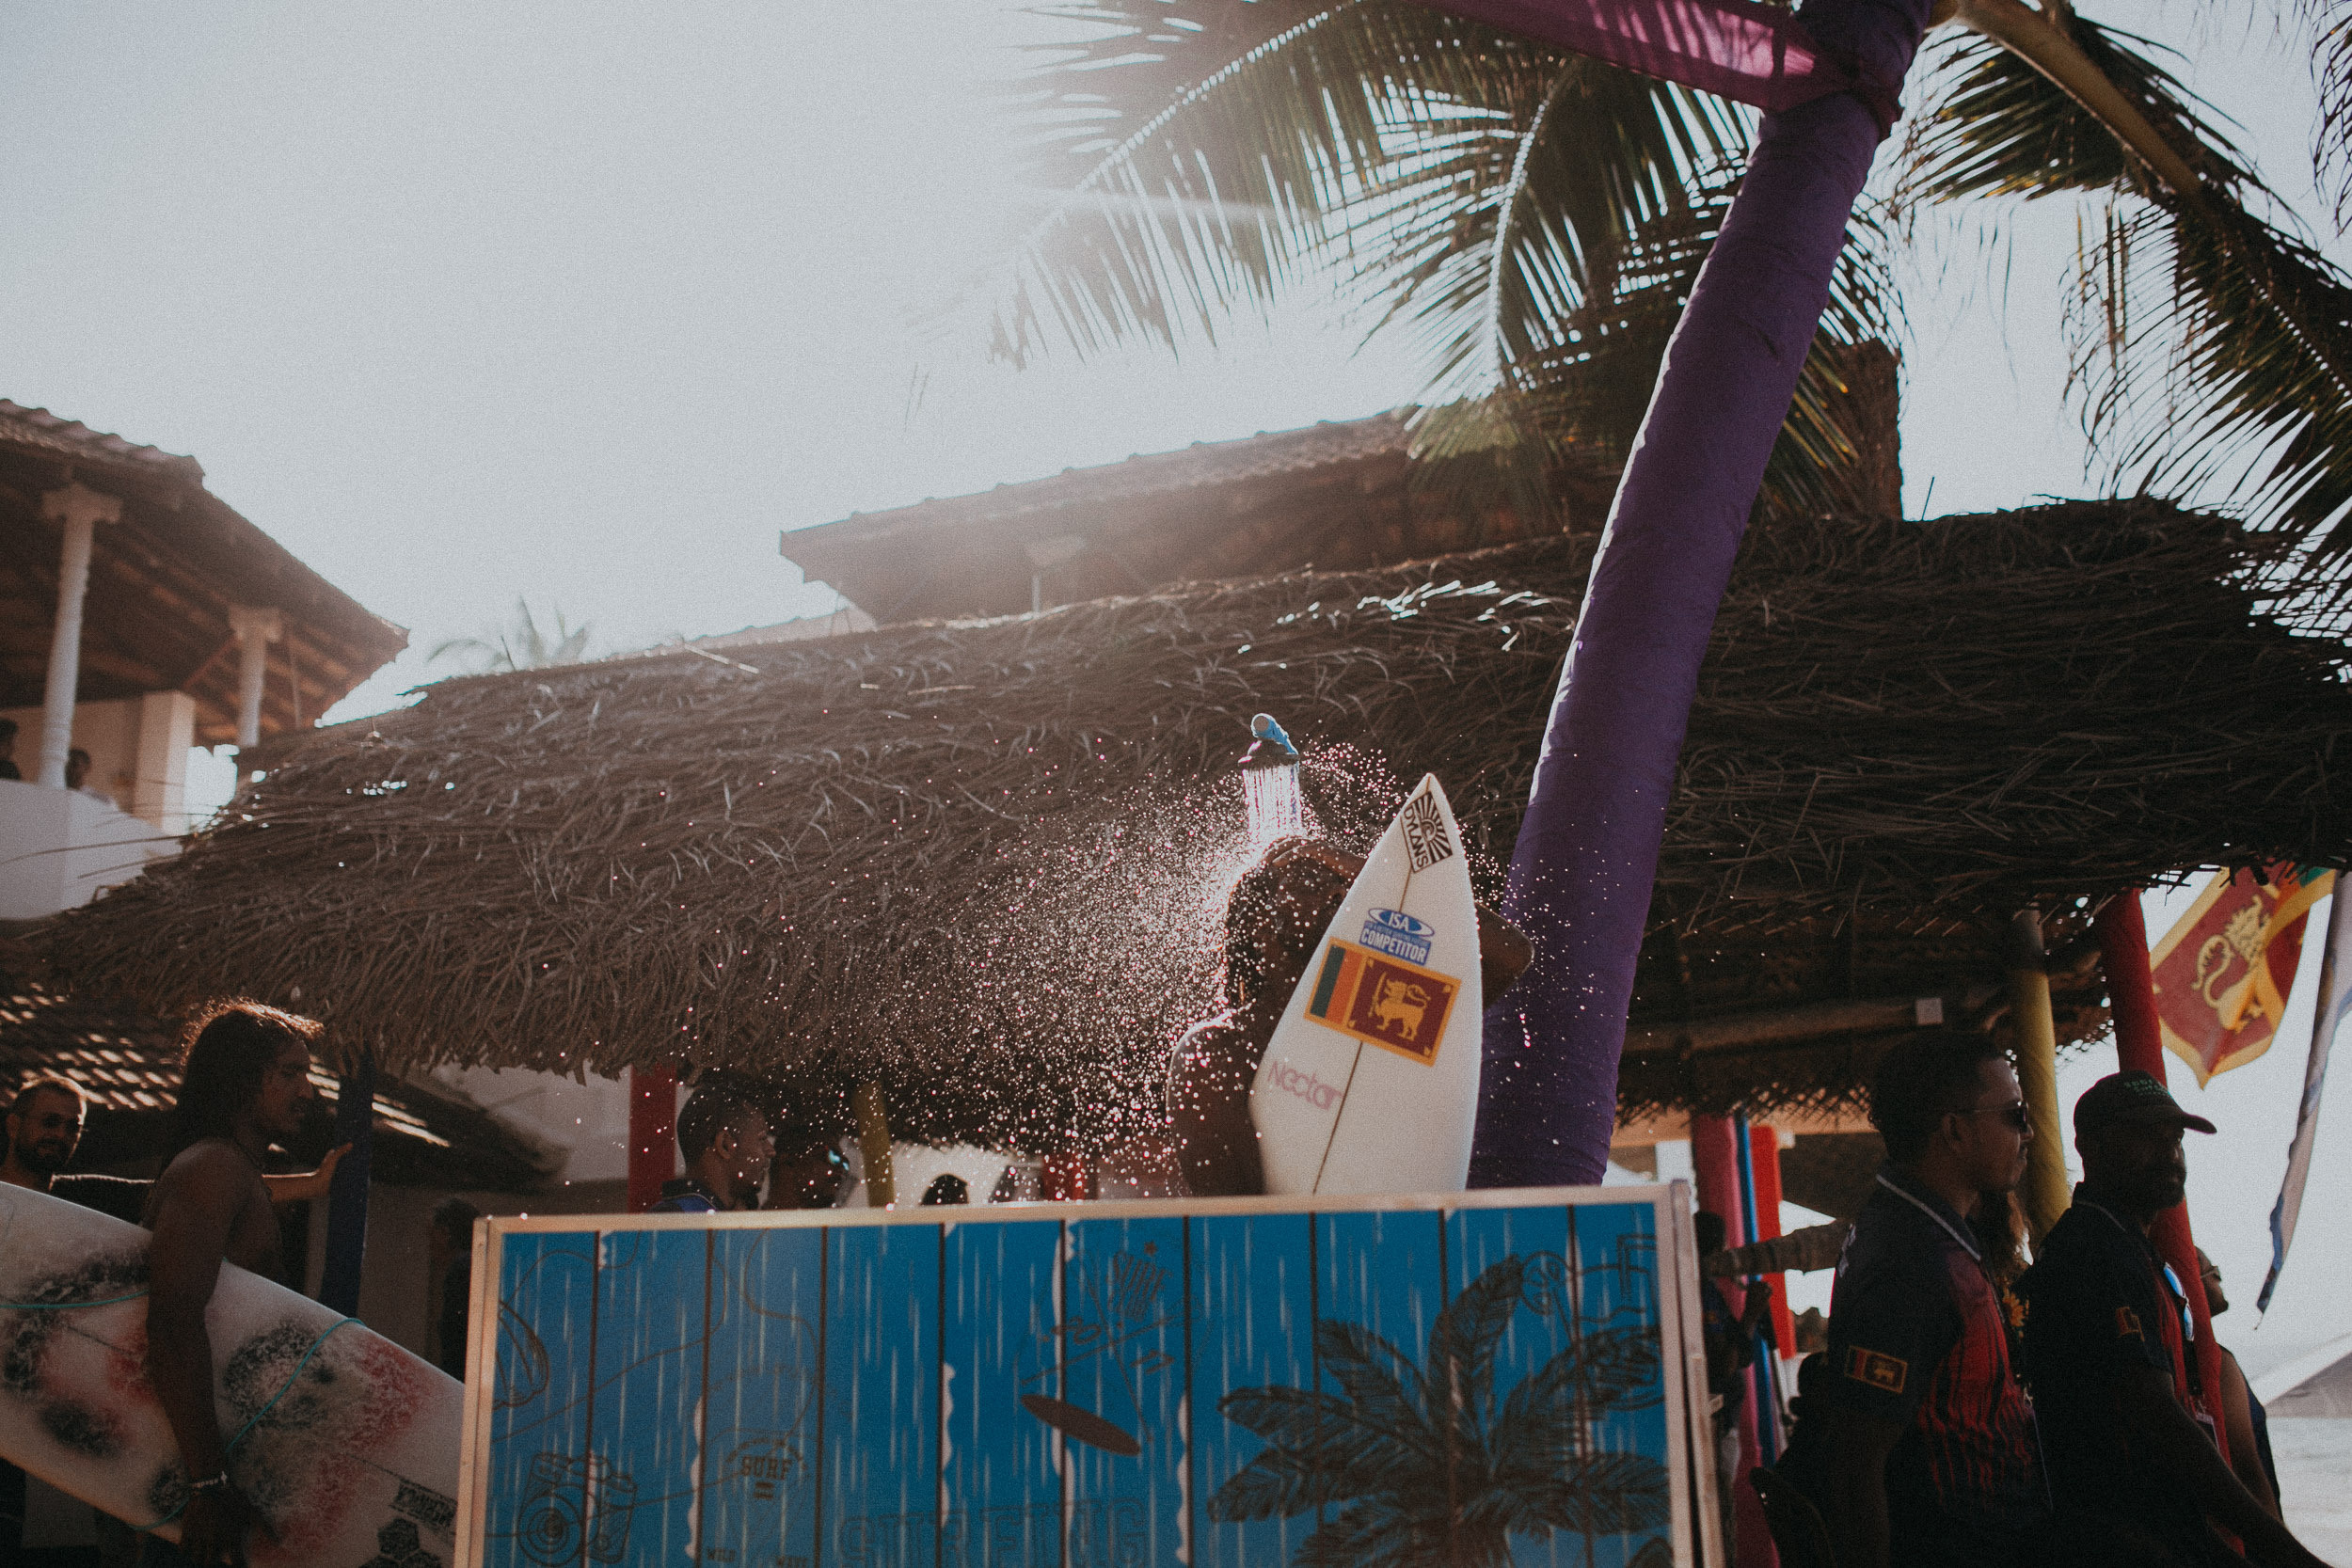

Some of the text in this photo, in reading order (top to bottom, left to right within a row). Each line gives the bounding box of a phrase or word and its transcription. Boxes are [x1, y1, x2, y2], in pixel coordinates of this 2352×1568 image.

[1404, 805, 1429, 868] DYLANS
[1388, 912, 1409, 932] ISA
[1360, 927, 1427, 963] COMPETITOR
[1266, 1060, 1343, 1111] Nectar
[740, 1454, 793, 1481] SURF
